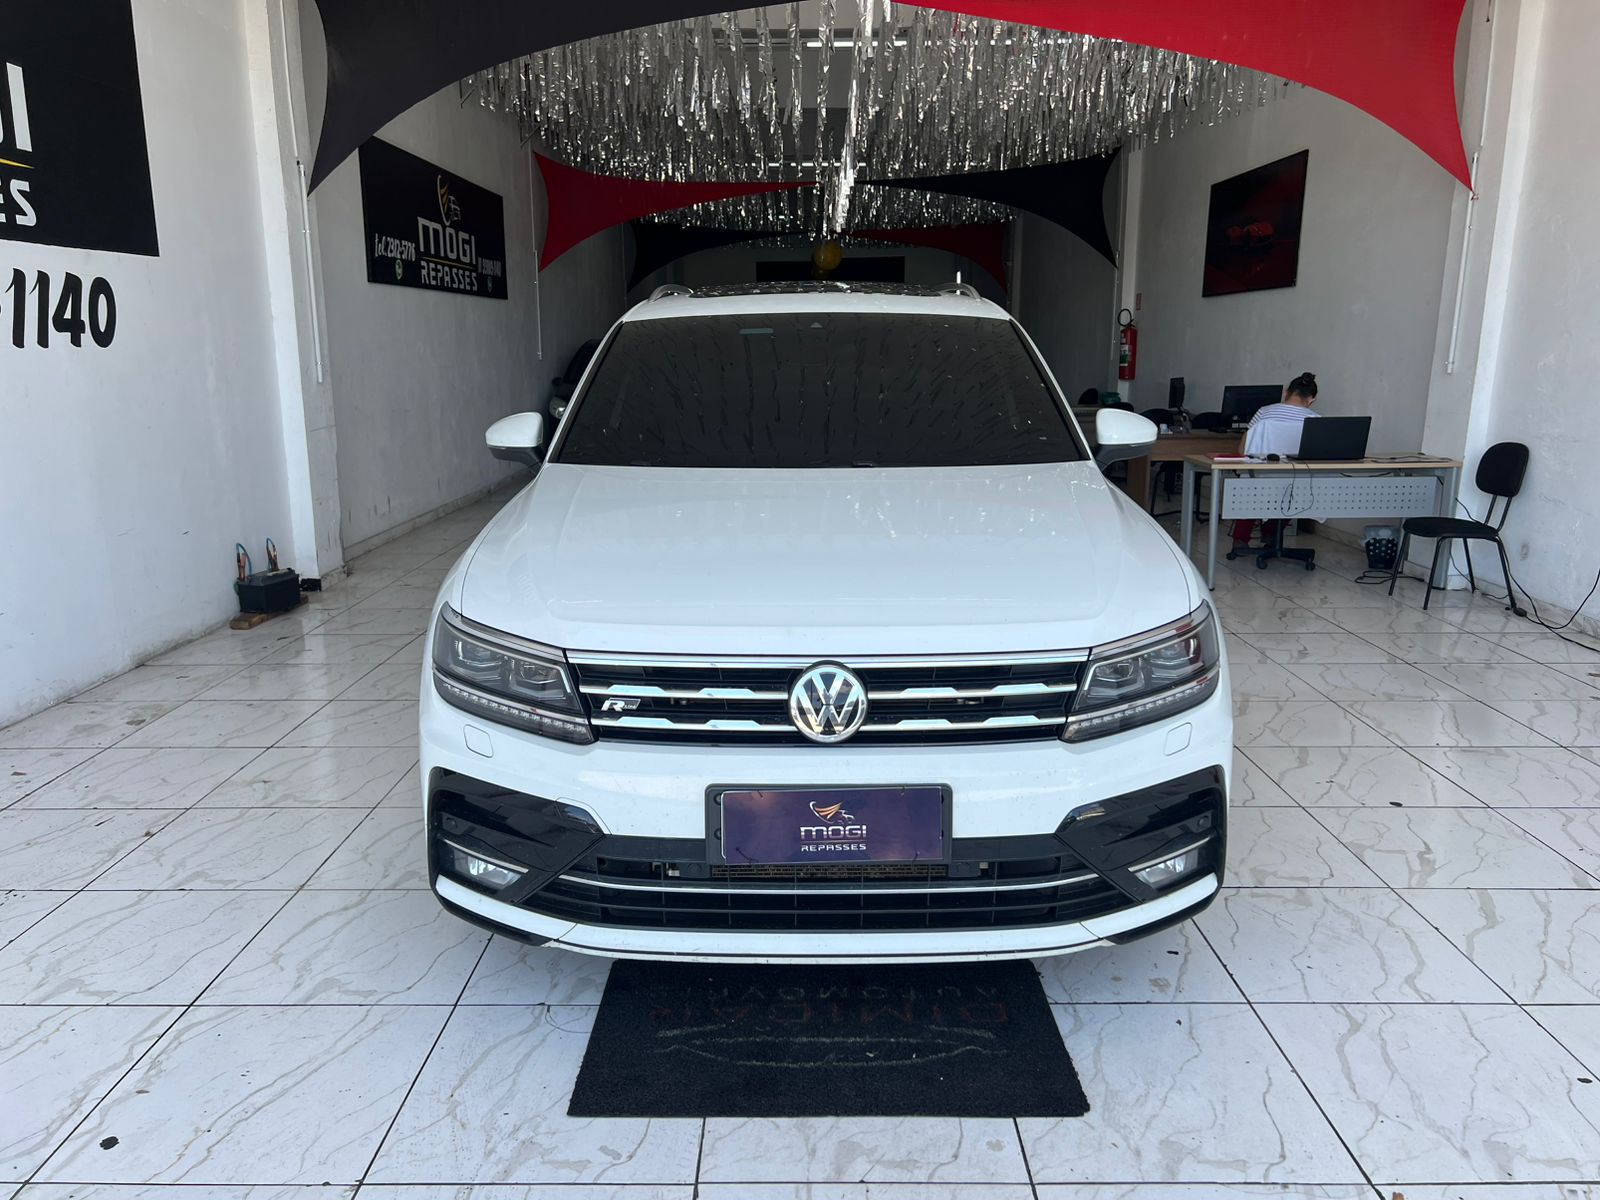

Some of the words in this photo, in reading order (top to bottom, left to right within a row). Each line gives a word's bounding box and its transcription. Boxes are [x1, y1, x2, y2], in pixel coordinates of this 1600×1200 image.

[417, 216, 476, 265] MOGI
[420, 260, 478, 291] REPASSES
[800, 825, 867, 839] MOGI
[801, 843, 867, 852] REPASSES
